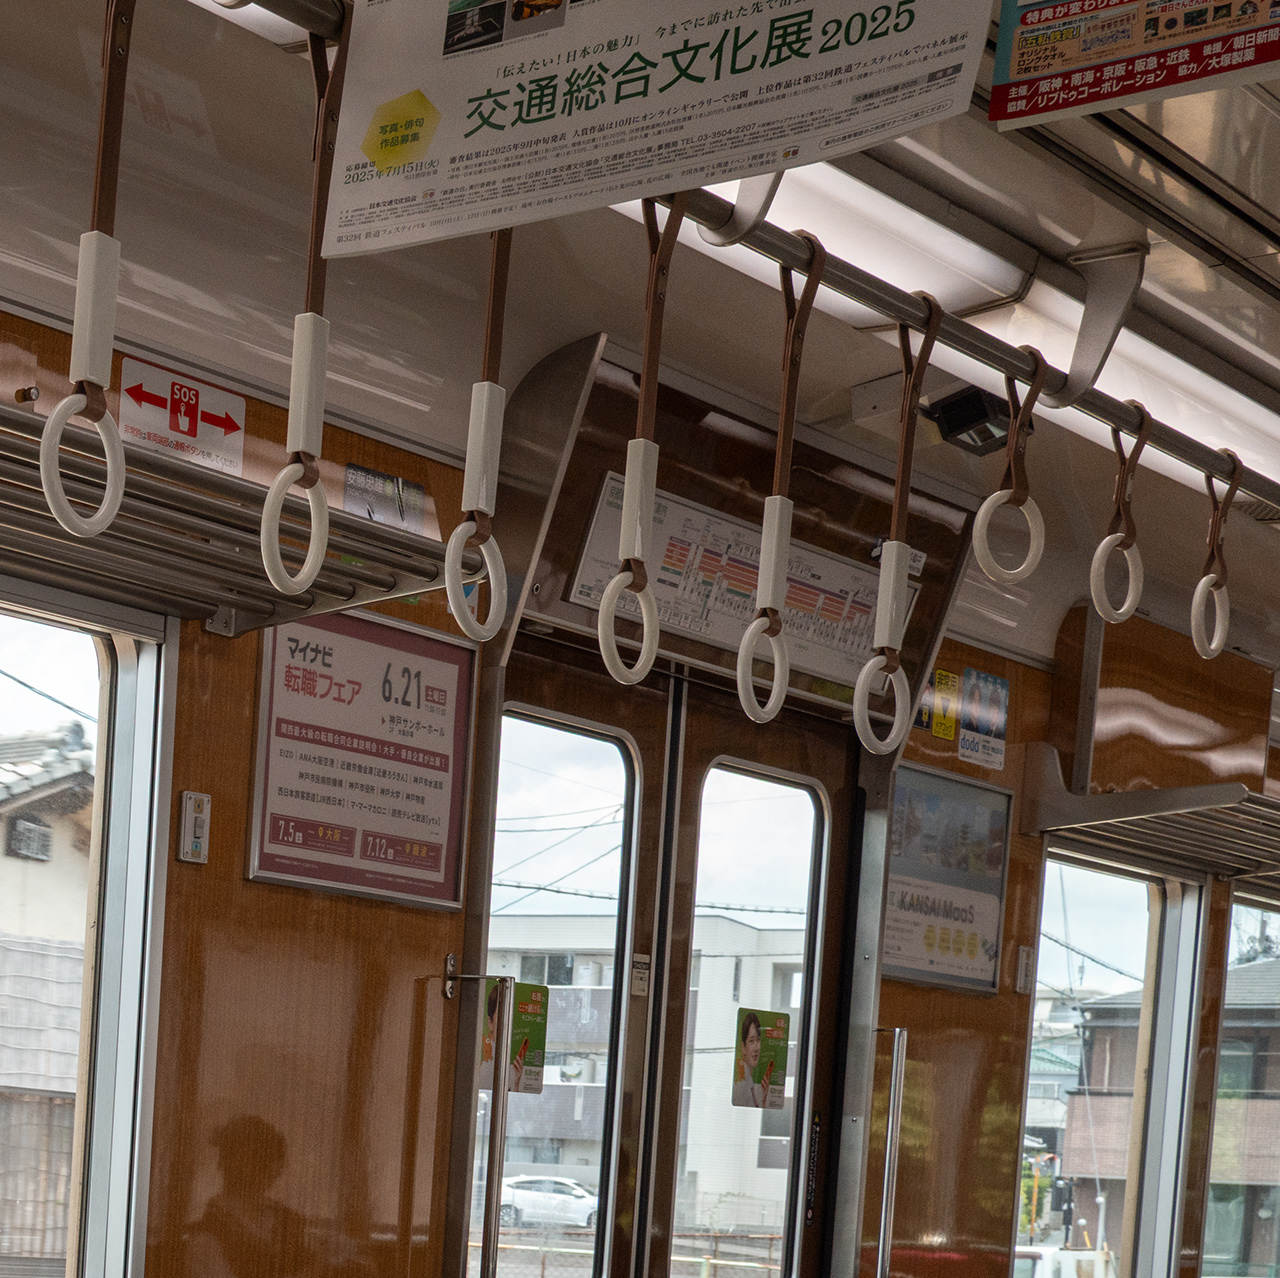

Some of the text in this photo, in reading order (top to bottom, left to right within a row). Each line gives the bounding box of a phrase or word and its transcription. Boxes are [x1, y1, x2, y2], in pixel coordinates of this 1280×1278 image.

[655, 0, 807, 39] 今までに訪れた先で出
[1025, 0, 1137, 24] 特典が変わりま
[1018, 25, 1081, 50] 「五私鉄賞」
[1202, 26, 1280, 57] 後援／朝日新聞
[1017, 51, 1066, 67] ロングタオル
[1018, 46, 1058, 59] オリジナル
[1016, 62, 1054, 75] 2枚セット
[378, 117, 425, 136] 写真・俳句
[379, 131, 421, 149] 作品募集
[173, 384, 197, 404] SOS
[285, 636, 333, 668] マイナビ
[380, 661, 423, 710] 6.21
[283, 662, 362, 708] 転職フェア
[279, 748, 293, 759] EIZO
[960, 733, 980, 753] doda
[277, 819, 295, 842] 7.5
[325, 826, 342, 842] 大阪
[366, 836, 387, 858] 7.12
[900, 890, 975, 924] KANSAI MaaS
